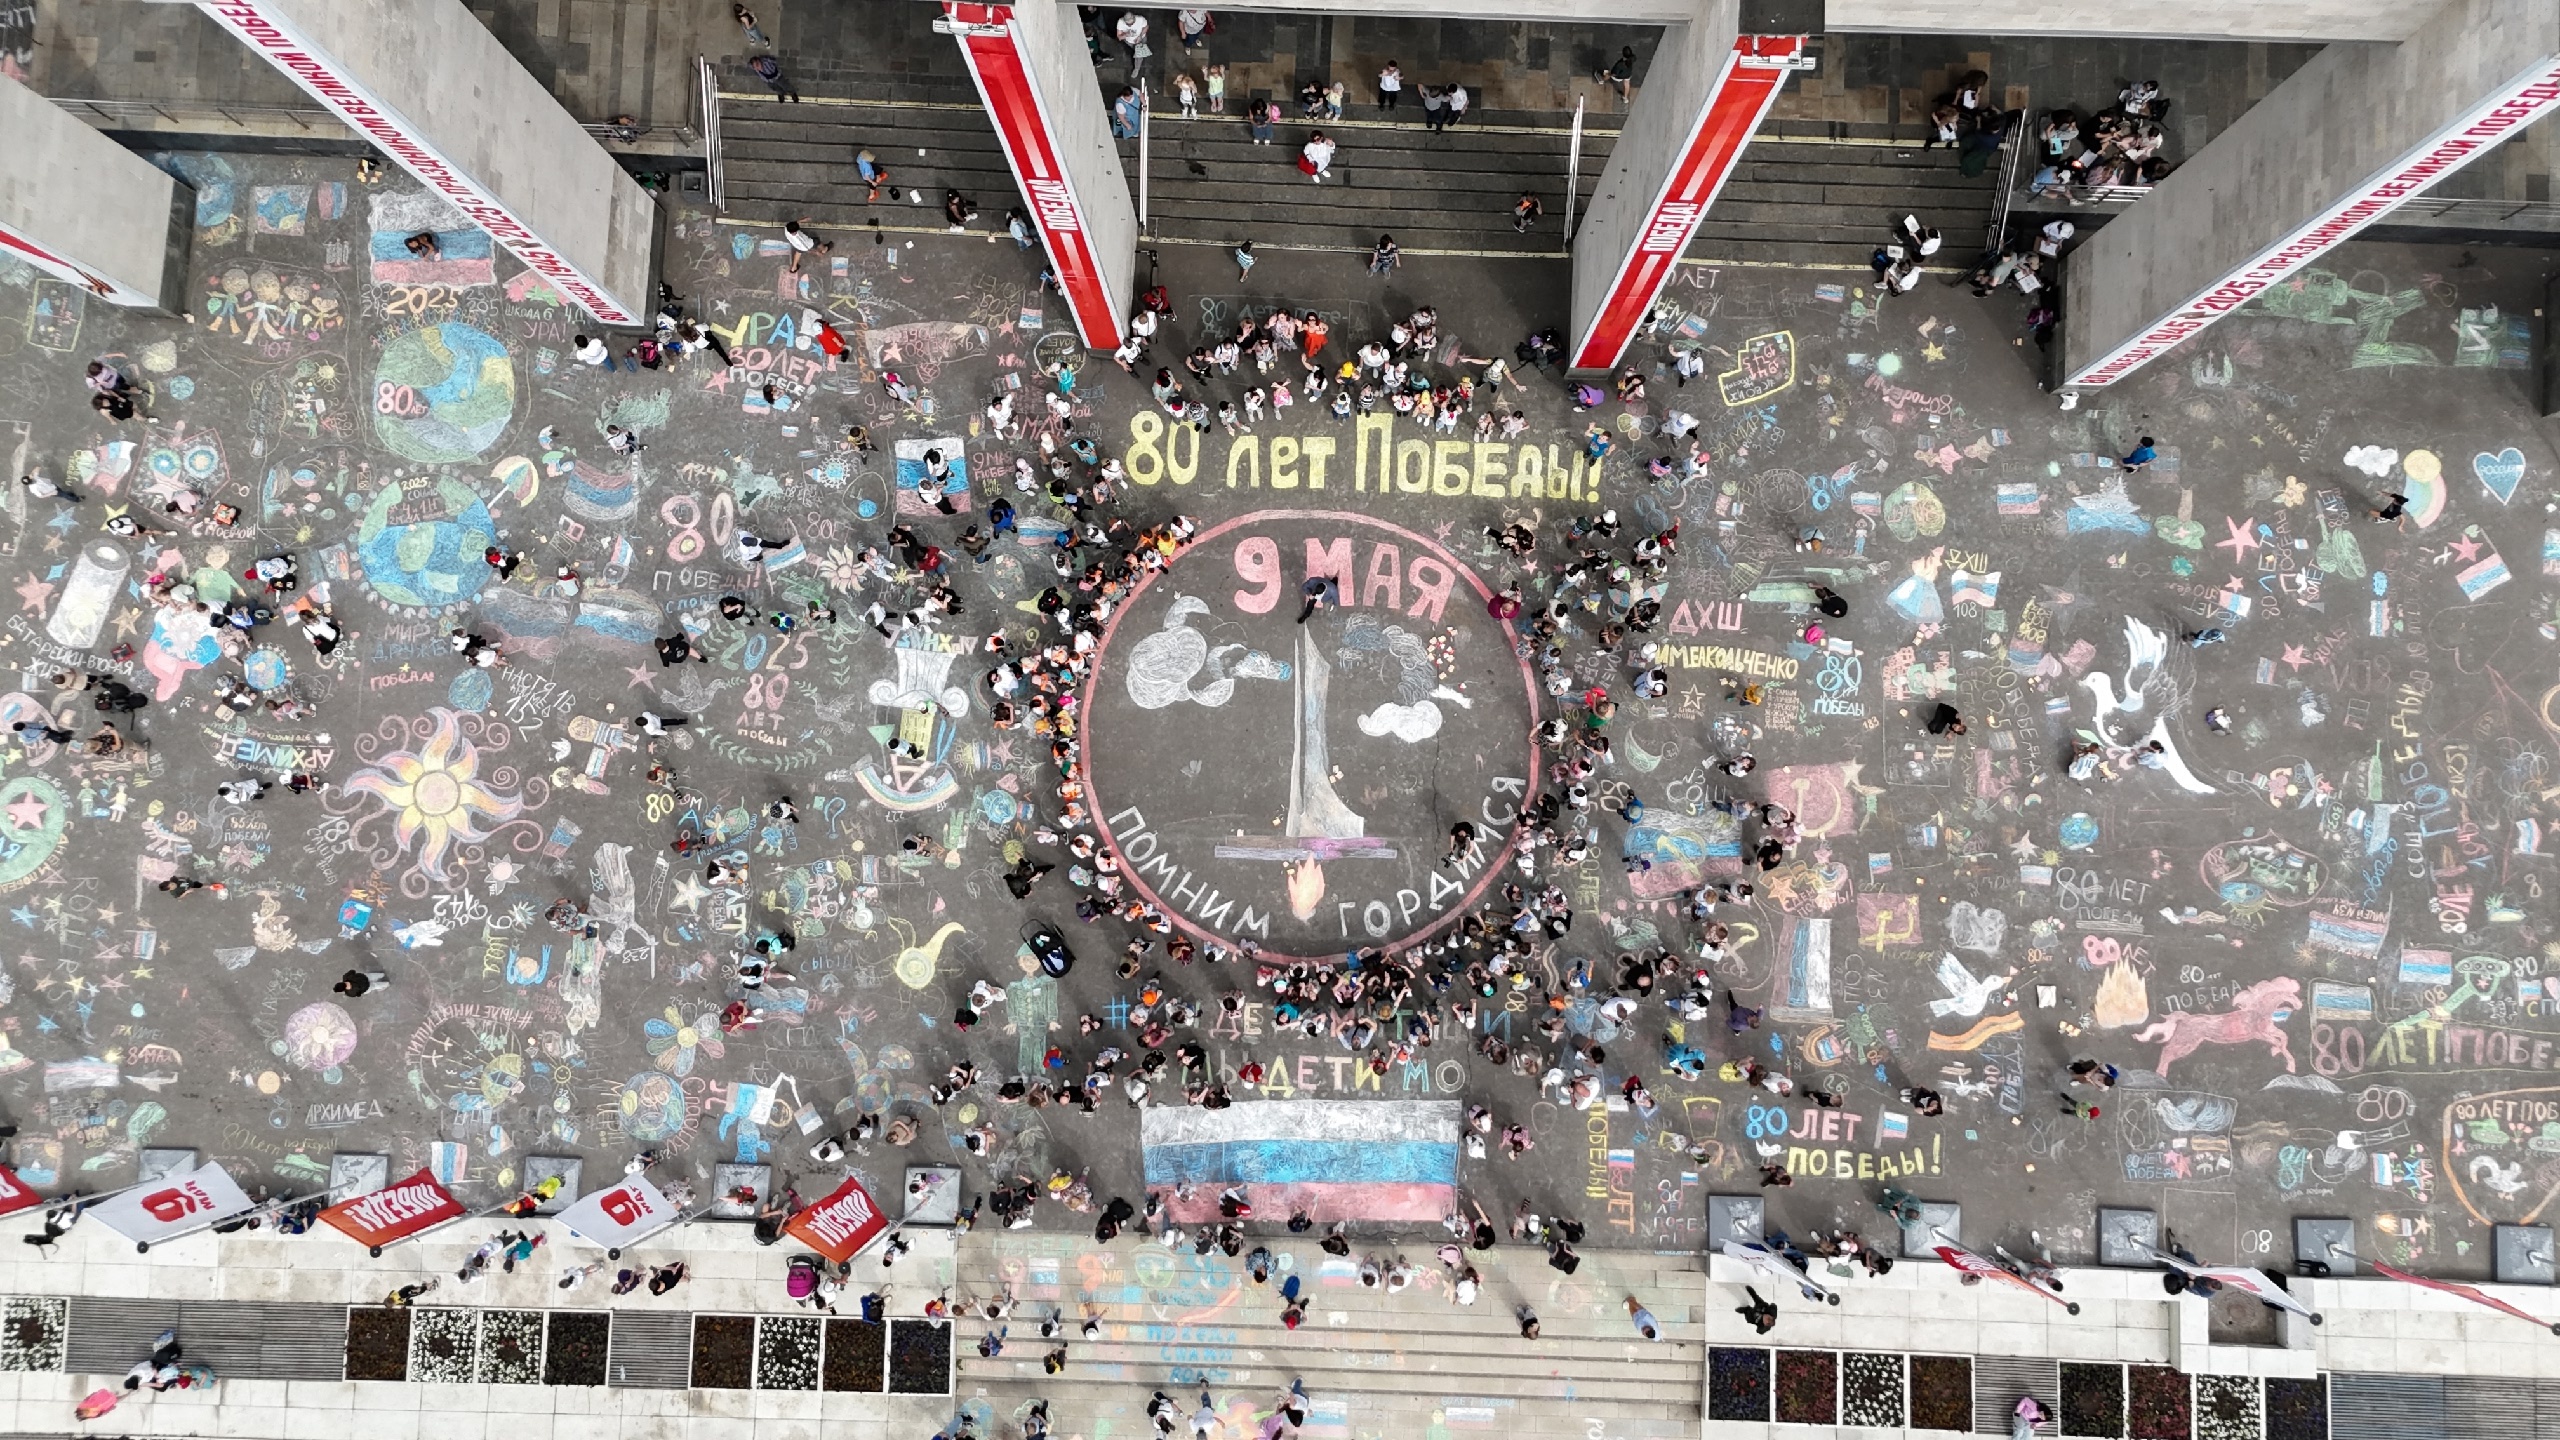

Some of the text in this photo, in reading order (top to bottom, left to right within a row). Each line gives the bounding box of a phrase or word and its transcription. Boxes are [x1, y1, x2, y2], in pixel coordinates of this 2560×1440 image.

[268, 48, 370, 118] ВЕЛИКОЙ
[357, 116, 474, 196] ПРАЗДНИКОМ
[455, 197, 484, 205] С
[1026, 178, 1080, 231] ПОБЕДА!
[460, 206, 533, 240] 2025
[1643, 201, 1699, 253] ПОБЕДА!
[518, 250, 578, 278] 1945
[2099, 344, 2153, 377] ПОБЕДА!
[2142, 312, 2196, 356] 1945
[2194, 278, 2264, 316] 2025
[2269, 198, 2385, 276] ПРАЗДНИКОМ
[2372, 134, 2478, 201] ВЕЛИКОЙ
[387, 285, 463, 315] 2025
[556, 278, 618, 315] ПОБЕДА!
[376, 380, 414, 414] 80
[1126, 410, 1199, 486] 80
[662, 492, 734, 563] 80
[1234, 535, 1456, 623] 9 МАЯ
[1668, 598, 1743, 637] ДХШ
[1953, 602, 1978, 618] 108
[384, 624, 431, 643] МИР
[719, 627, 819, 672] 2025
[743, 671, 789, 711] 80
[1815, 655, 1864, 692] 80
[736, 711, 785, 731] ЛЕТ
[1812, 698, 1866, 718] ПОБЕДЫ
[221, 731, 337, 768] АРХИМЕД
[645, 793, 676, 823] 80
[1108, 804, 1271, 939] ПОМНИМ
[2180, 964, 2205, 984] 80
[2312, 1023, 2365, 1075] 80
[2451, 1024, 2560, 1070] ПОБЕ
[1259, 1053, 1381, 1099] ДЕТИ
[305, 1099, 385, 1128] АРХИМЕД
[1745, 1104, 1862, 1141] 80 ЛЕТ
[2356, 1087, 2405, 1122] 80
[2480, 1102, 2518, 1120] ЛЕТ
[1786, 1132, 1941, 1181] ПОБЕДЫ!
[342, 1182, 447, 1233] ПОБЕДА!
[807, 1188, 873, 1248] ПОБЕДА!
